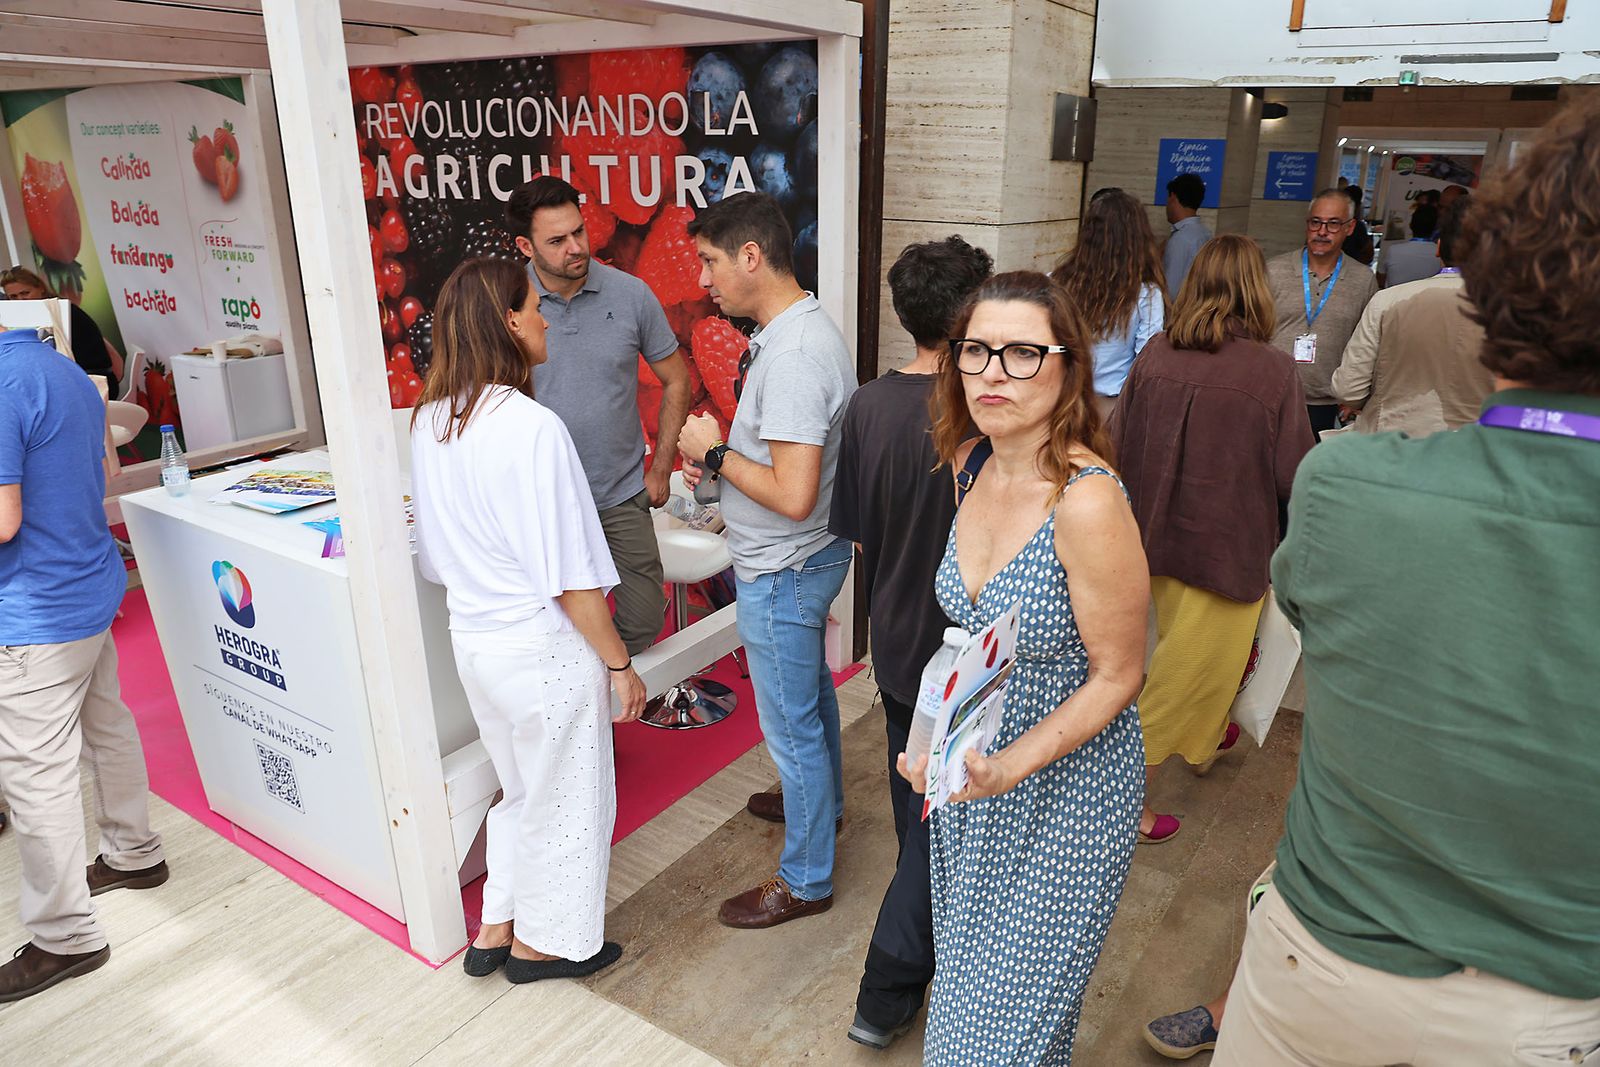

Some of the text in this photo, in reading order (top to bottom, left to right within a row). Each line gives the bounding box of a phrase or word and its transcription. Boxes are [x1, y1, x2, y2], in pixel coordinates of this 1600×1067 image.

[366, 90, 759, 139] REVOLUCIONANDO LA
[80, 121, 94, 135] Our
[96, 122, 125, 138] concept
[101, 154, 151, 180] Calinda
[110, 200, 160, 226] Balada
[204, 235, 233, 248] FRESH
[211, 249, 255, 263] FORWARD
[124, 288, 177, 315] bachata
[225, 652, 283, 686] GROUP
[222, 705, 318, 758] CANAL DE WHATSAPP
[260, 710, 274, 724] EN
[278, 719, 332, 754] NUESTRO
